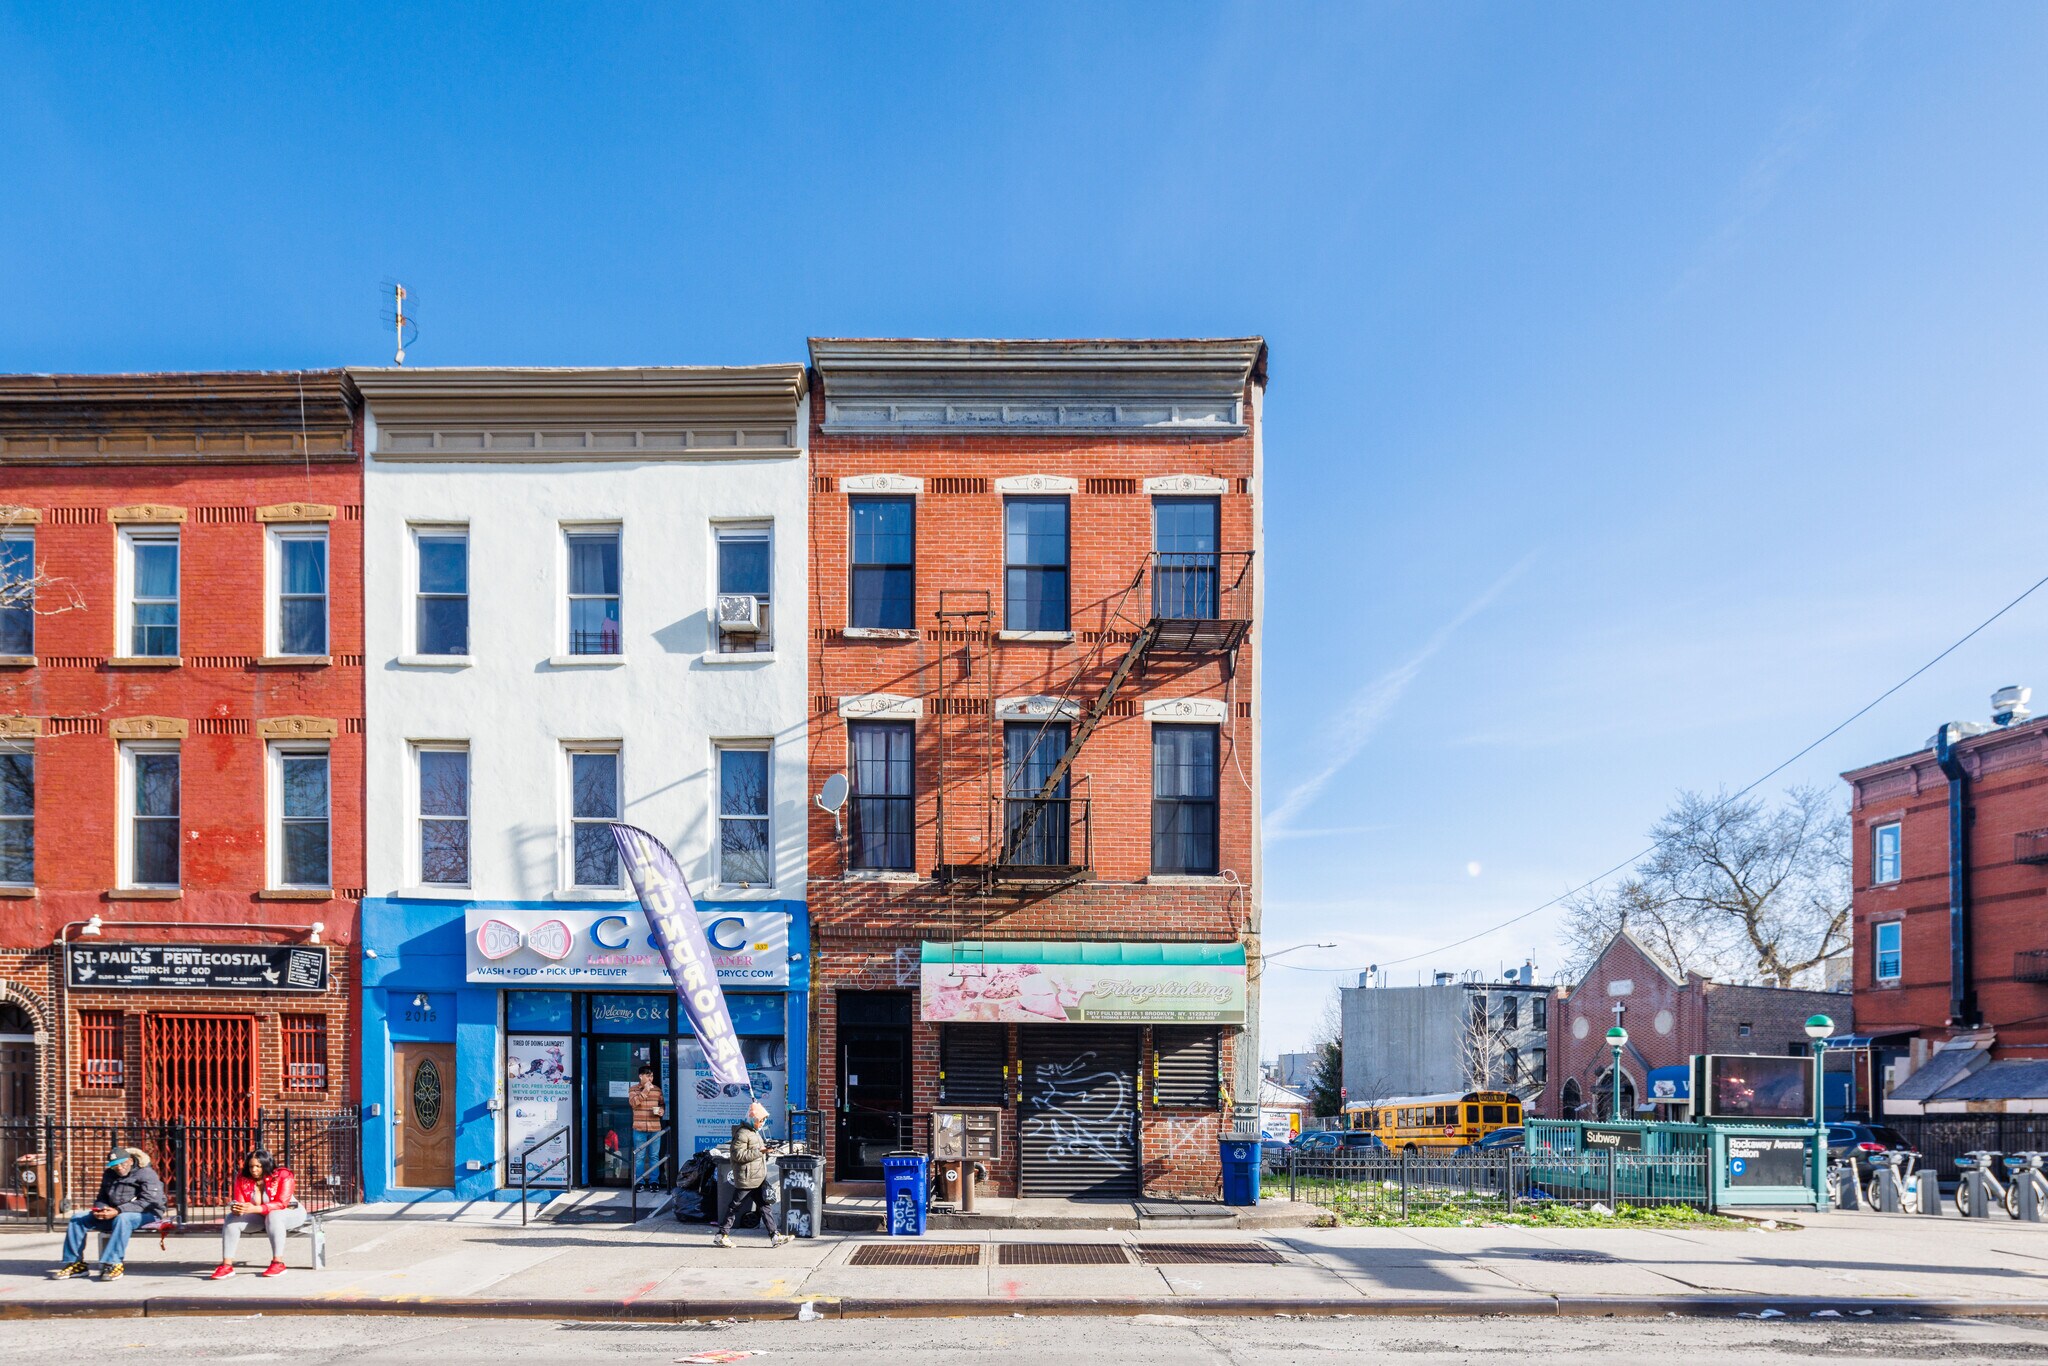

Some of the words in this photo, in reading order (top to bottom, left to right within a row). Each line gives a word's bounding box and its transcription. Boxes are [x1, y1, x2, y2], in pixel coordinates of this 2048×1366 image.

[590, 915, 630, 950] C
[707, 917, 747, 951] C
[73, 951, 97, 964] ST.
[99, 951, 151, 964] PAUL'S
[163, 953, 271, 966] PENTECOSTAL
[587, 954, 653, 966] LAUNDRY
[713, 956, 753, 966] ANER
[131, 966, 170, 974] CHURCH
[174, 967, 187, 975] OF
[191, 967, 211, 975] GOD
[477, 967, 505, 975] WASH
[546, 968, 567, 976] PICK
[590, 968, 627, 976] DELIVER
[1092, 979, 1233, 1004] Fingerlinking
[404, 1011, 437, 1022] 2015
[592, 1004, 634, 1020] Welcome
[636, 1008, 648, 1019] C
[650, 1008, 661, 1019] &
[1586, 1131, 1621, 1146] Subway
[1729, 1139, 1772, 1151] Rockaway
[1773, 1140, 1804, 1149] Avenue
[1729, 1148, 1760, 1158] Station
[1733, 1161, 1743, 1172] C
